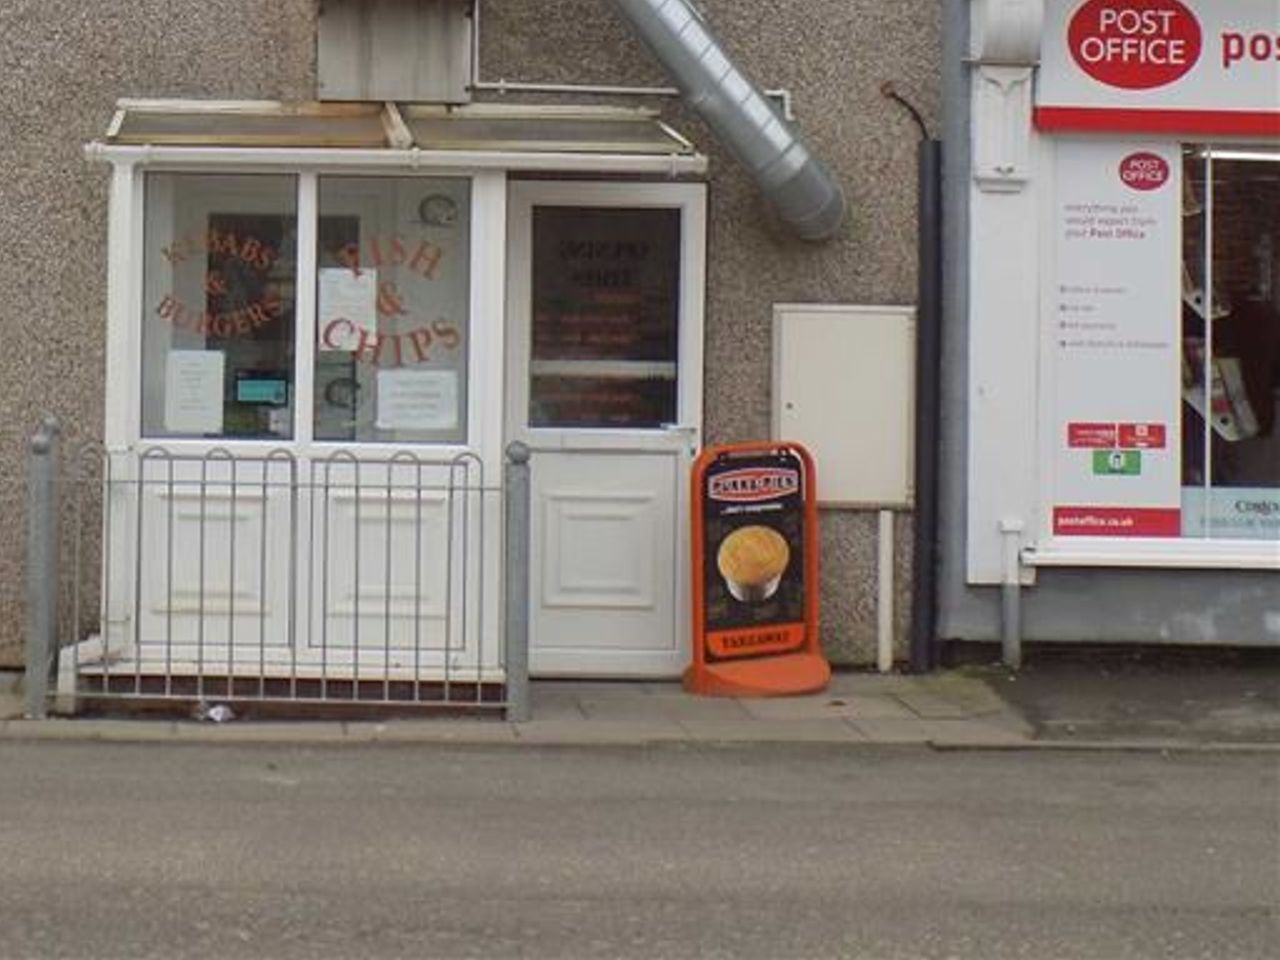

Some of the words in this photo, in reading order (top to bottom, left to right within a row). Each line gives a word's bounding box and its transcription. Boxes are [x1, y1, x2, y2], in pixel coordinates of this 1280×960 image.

[1099, 9, 1176, 35] POST
[1080, 37, 1185, 64] OFFICE
[1221, 32, 1280, 69] po
[1123, 170, 1163, 181] OFFICE
[1129, 159, 1159, 170] POST
[323, 318, 460, 366] CHIPS
